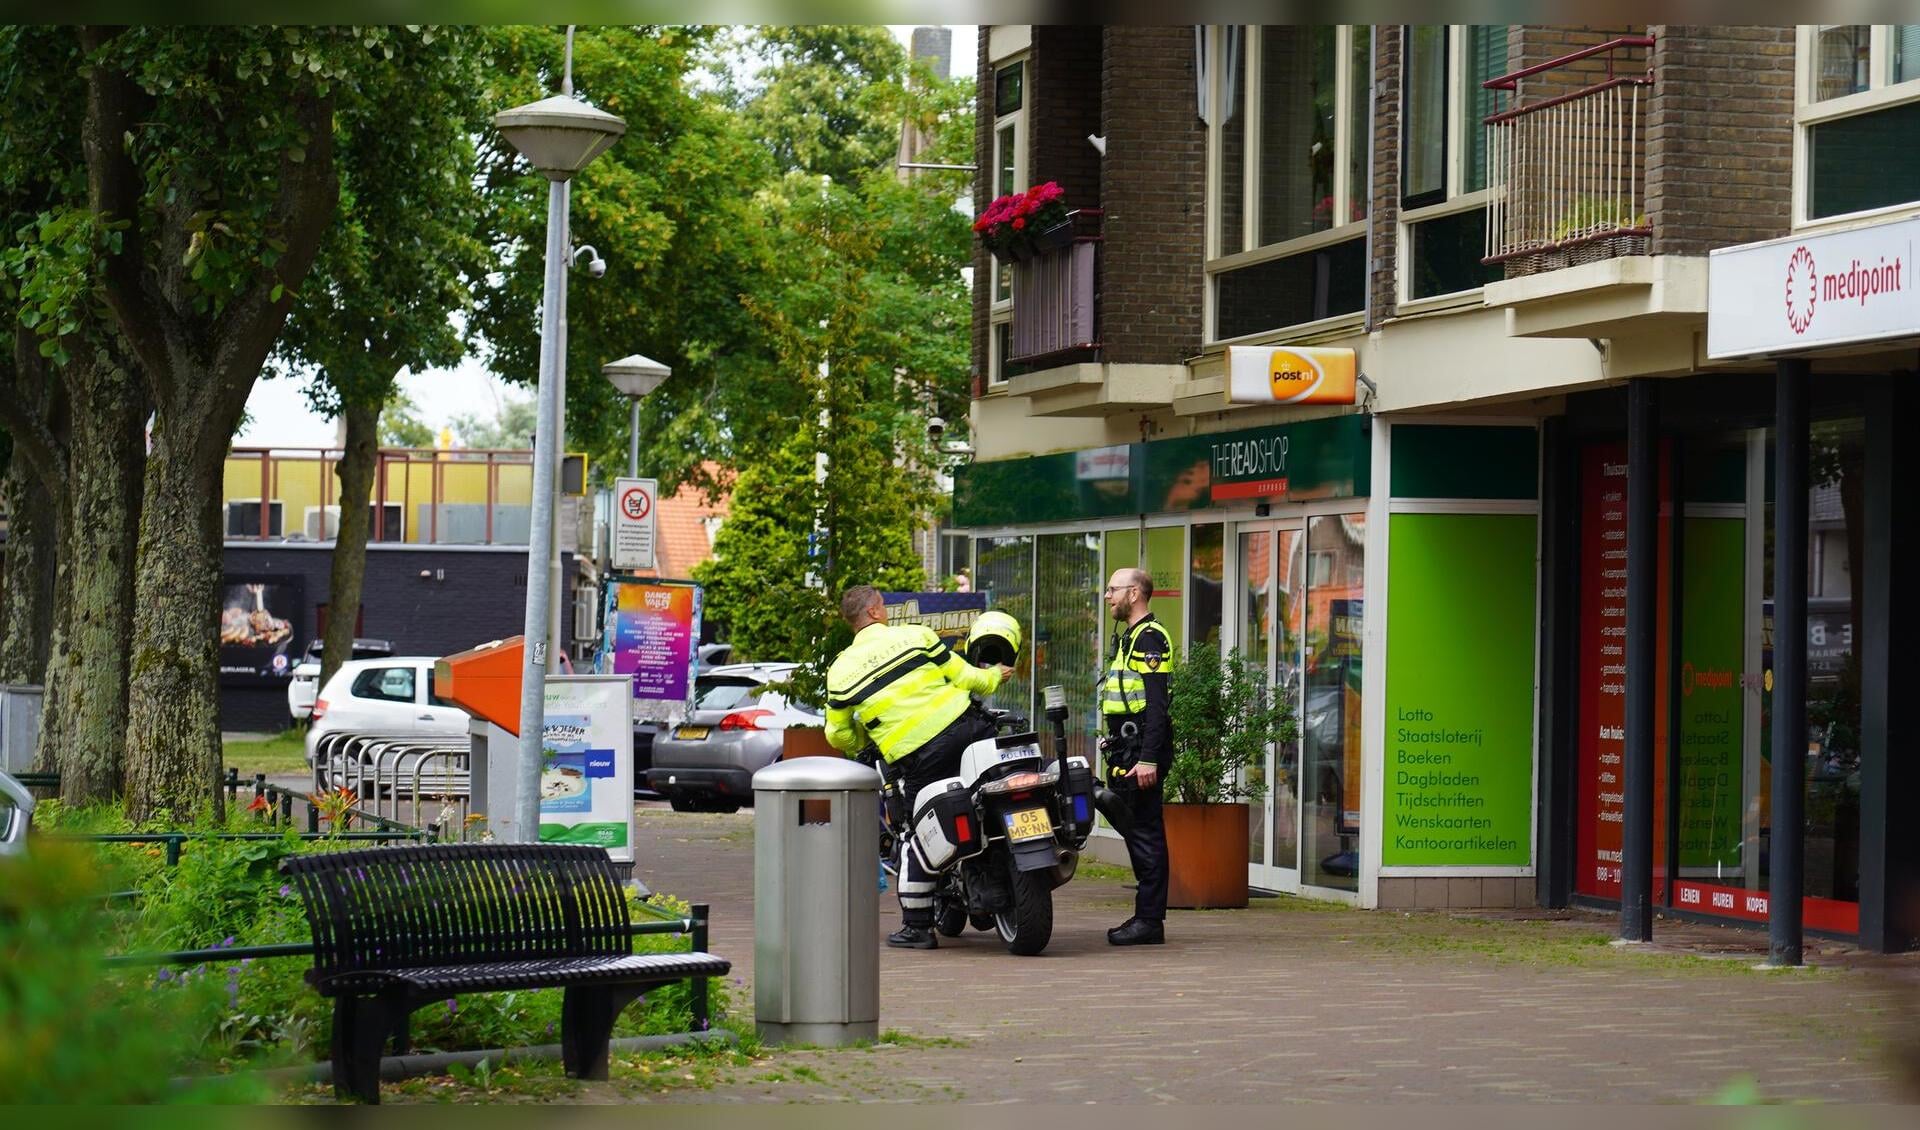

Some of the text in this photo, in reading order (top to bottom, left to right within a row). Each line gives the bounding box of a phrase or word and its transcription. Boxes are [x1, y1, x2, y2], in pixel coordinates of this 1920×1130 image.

[1823, 256, 1901, 306] medipoint
[1398, 707, 1434, 722] Lotto
[1397, 728, 1482, 747] Staatsloterij
[1000, 749, 1036, 761] POLITIE
[1397, 750, 1451, 765] Boeken
[1396, 771, 1480, 789] Dagbladen
[1396, 792, 1485, 810] Tijdschriften
[1020, 811, 1038, 824] 05
[1395, 813, 1492, 829] Wenskaarten
[1396, 834, 1517, 851] Kantoorartikelen
[1597, 849, 1623, 863] www.med
[1680, 887, 1768, 914] LENEN HUREN KOPEN
